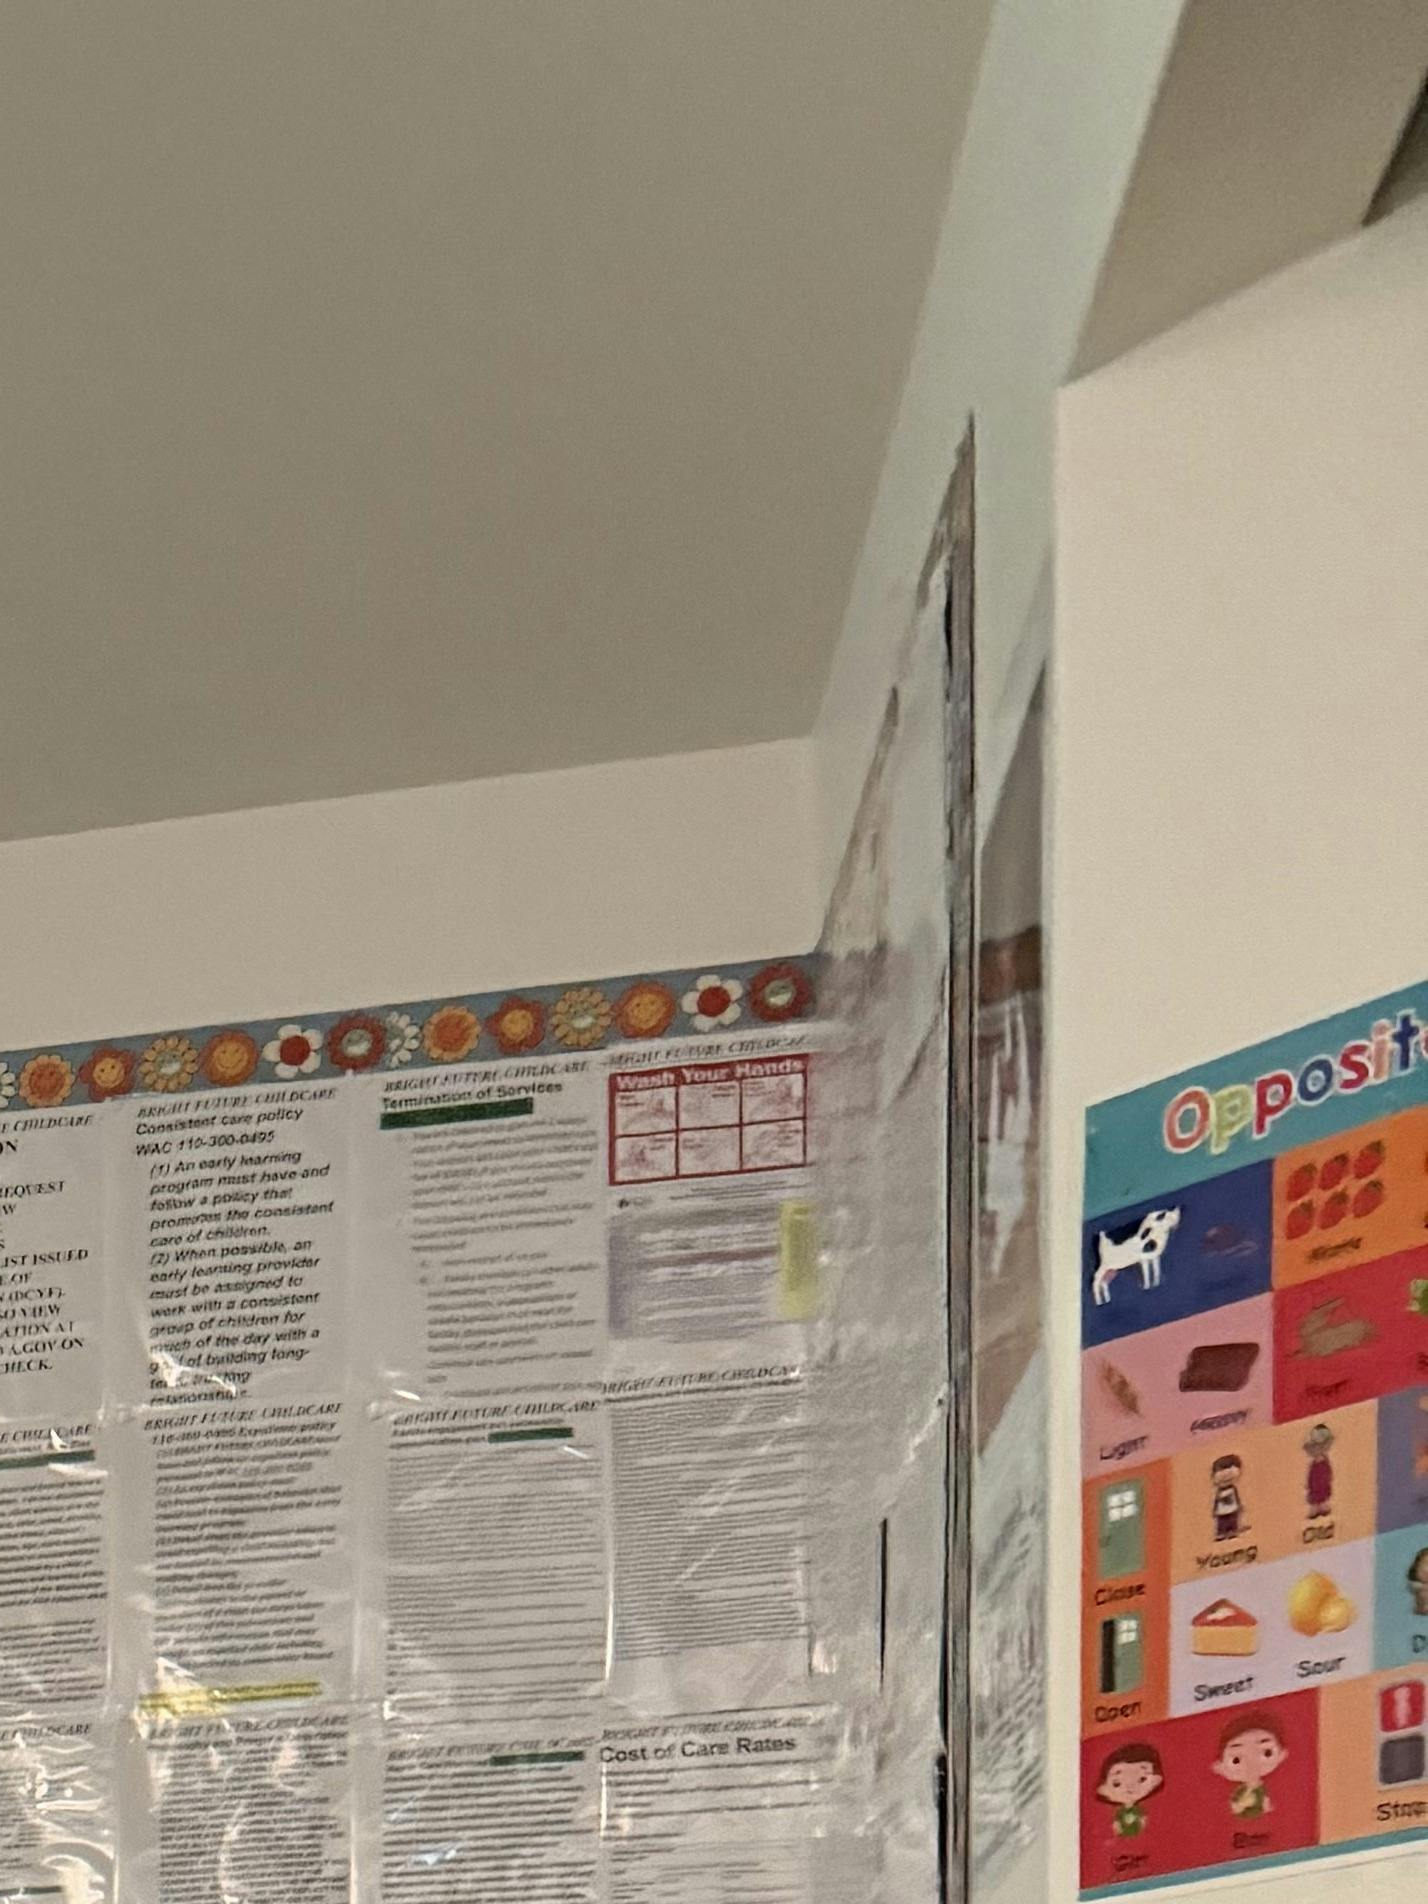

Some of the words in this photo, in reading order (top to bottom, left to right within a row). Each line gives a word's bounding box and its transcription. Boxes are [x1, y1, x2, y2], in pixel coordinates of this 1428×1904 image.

[615, 1071, 675, 1092] Wash
[681, 1064, 730, 1086] Your
[735, 1058, 803, 1081] Hands
[381, 1089, 471, 1111] Termination
[473, 1086, 492, 1101] of
[136, 1115, 217, 1136] Consistent
[221, 1113, 252, 1125] care
[257, 1107, 303, 1124] policy
[136, 1141, 172, 1157] WAC
[199, 1156, 235, 1172] early
[33, 1249, 89, 1265] ISSUED
[1196, 1545, 1258, 1569] Young
[1296, 1655, 1347, 1679] Sour
[1193, 1676, 1254, 1702] Sweet
[600, 1744, 648, 1765] Cost
[654, 1743, 676, 1758] of
[681, 1739, 730, 1758] Care
[736, 1734, 797, 1755] Rates
